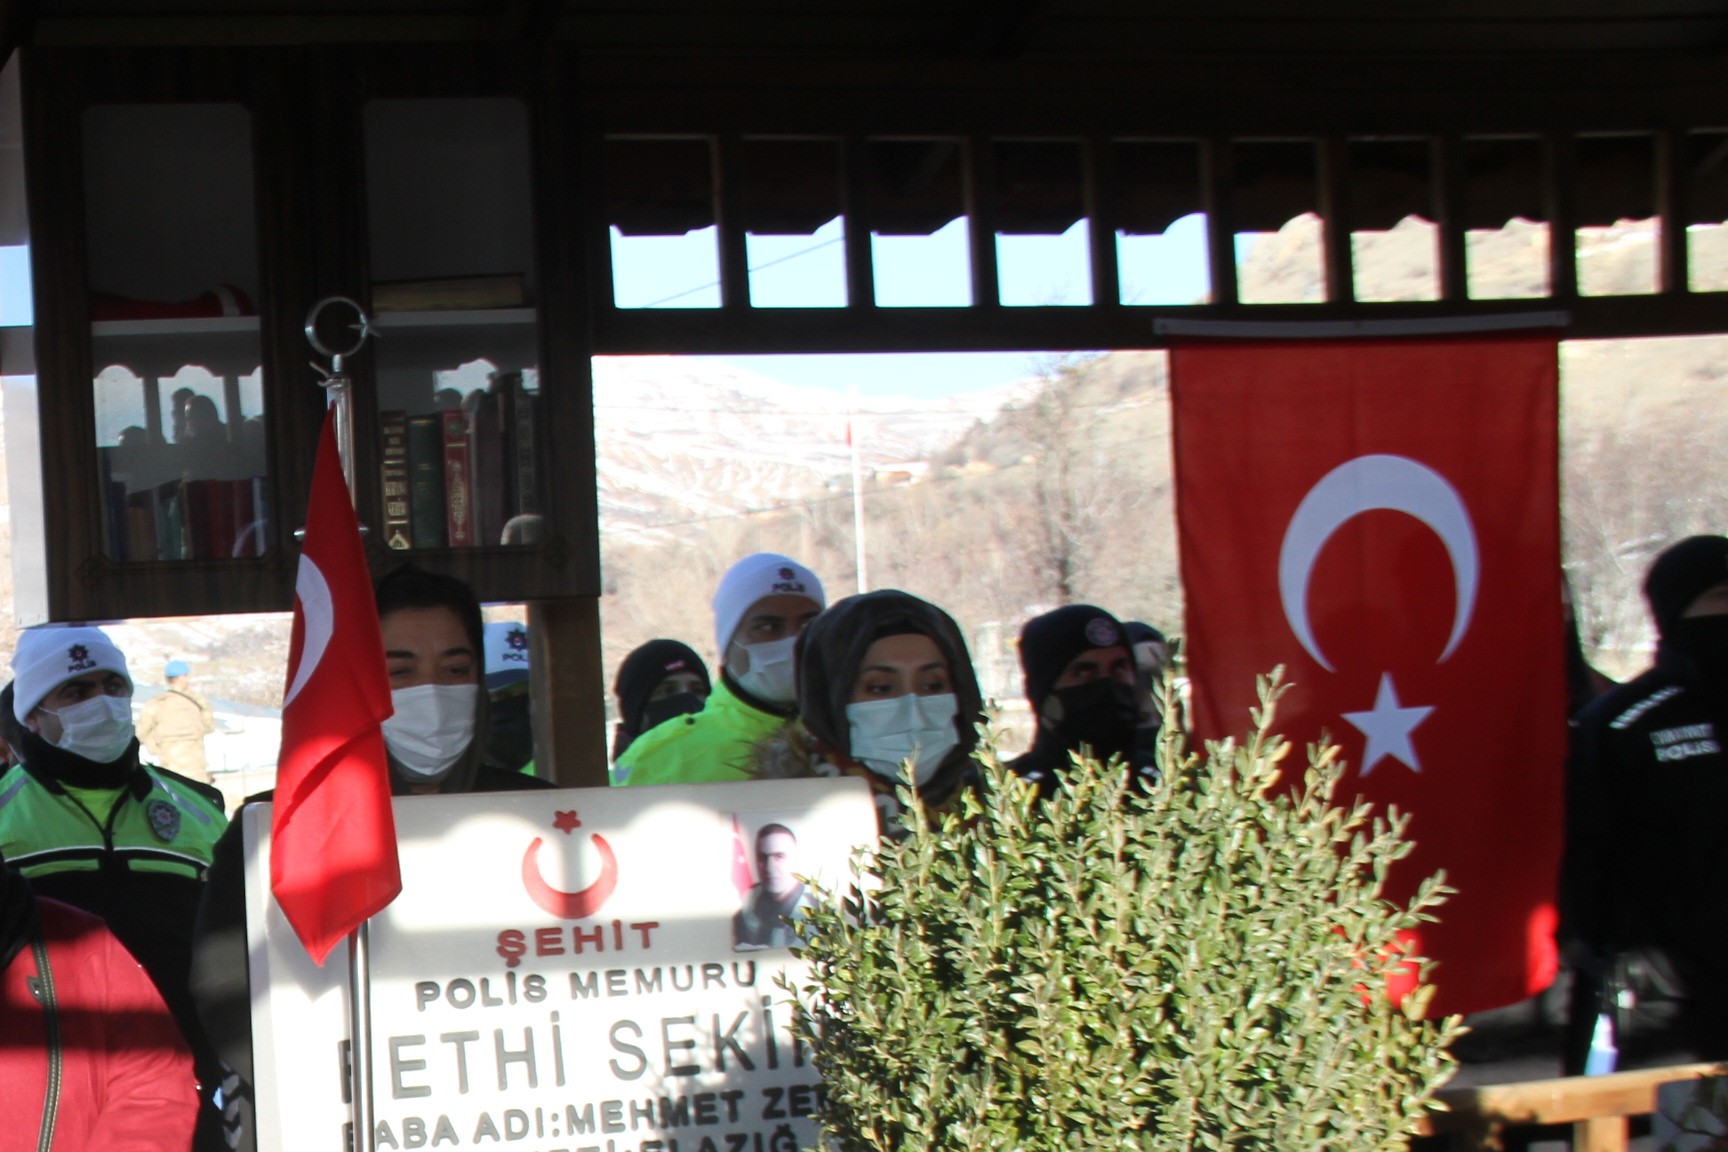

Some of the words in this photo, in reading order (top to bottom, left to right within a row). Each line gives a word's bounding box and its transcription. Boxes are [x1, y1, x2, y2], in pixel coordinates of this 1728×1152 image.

[496, 919, 659, 968] ŞEHİT
[415, 971, 547, 1012] POLİS
[569, 960, 756, 1000] MEMURU
